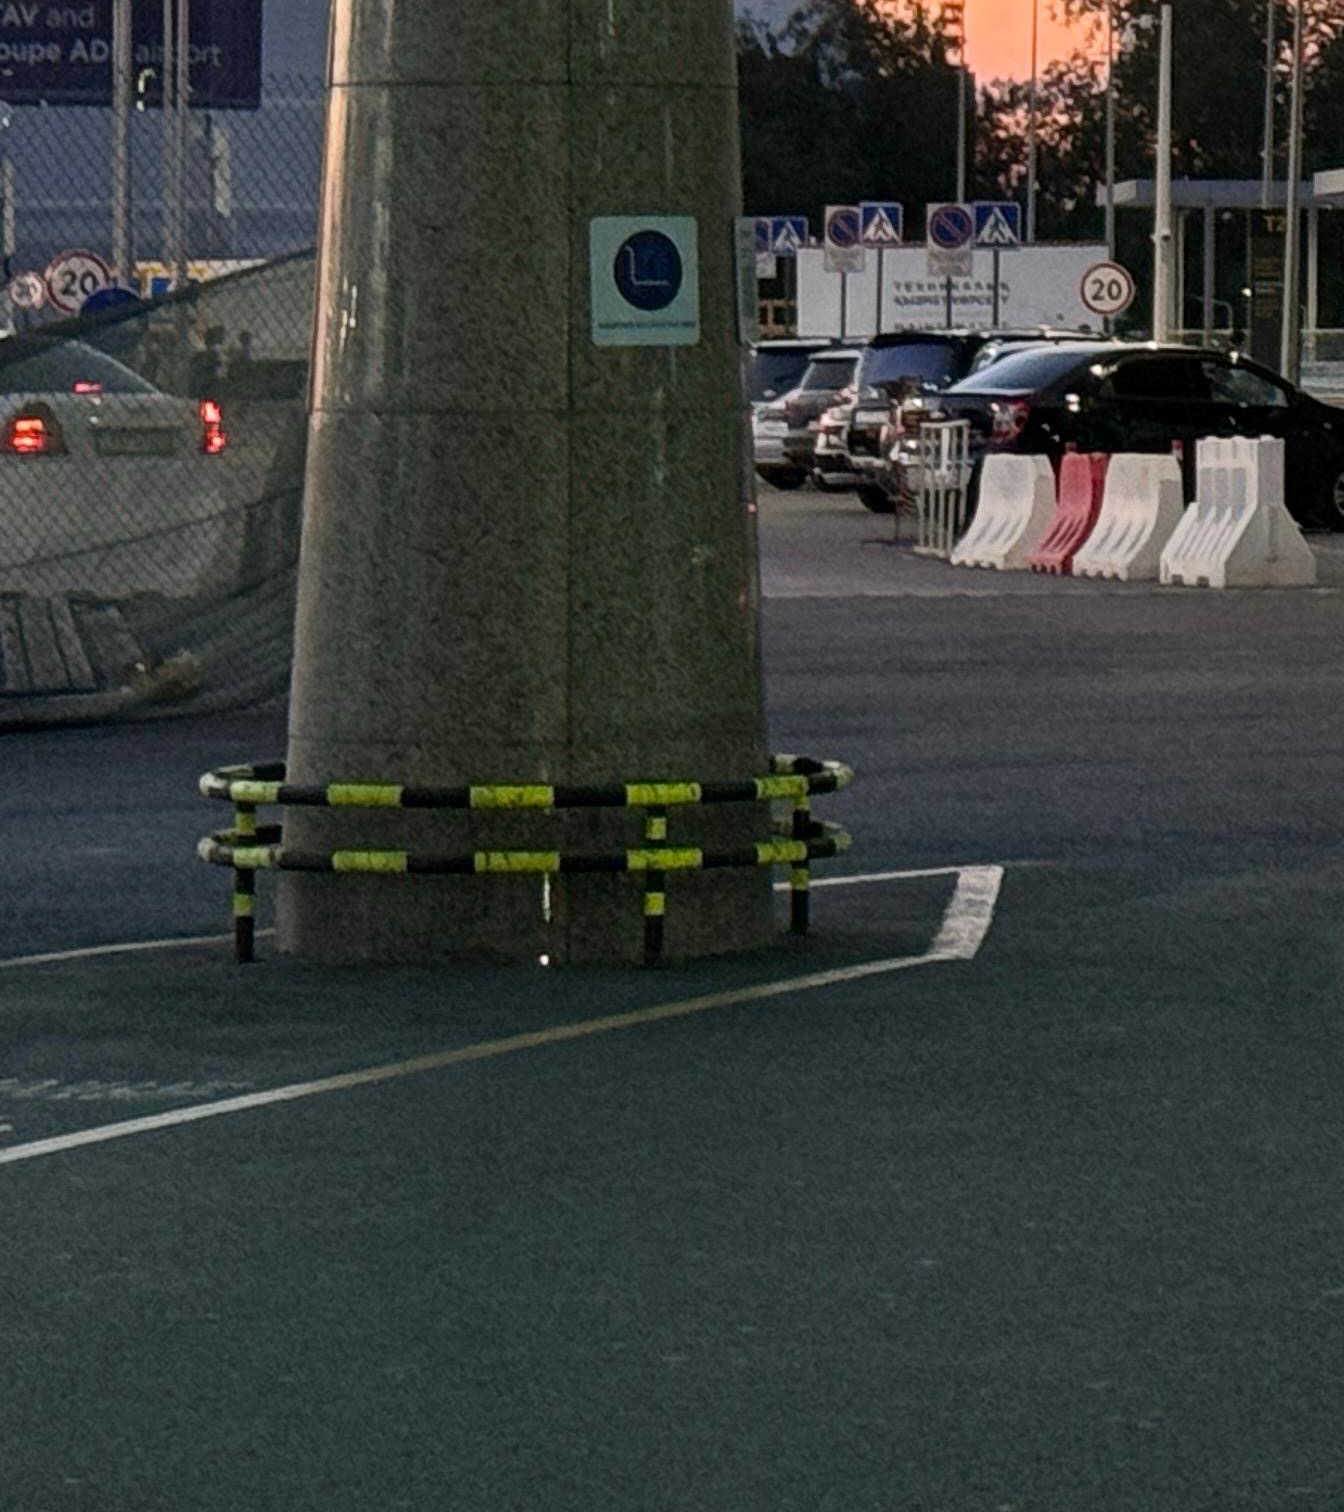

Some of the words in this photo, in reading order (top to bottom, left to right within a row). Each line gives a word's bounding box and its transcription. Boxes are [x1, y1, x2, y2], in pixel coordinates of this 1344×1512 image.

[0, 2, 38, 27] AV
[46, 4, 95, 29] and
[70, 37, 112, 63] AD
[135, 41, 222, 68] airort
[59, 269, 99, 296] 20
[1090, 279, 1122, 302] 20
